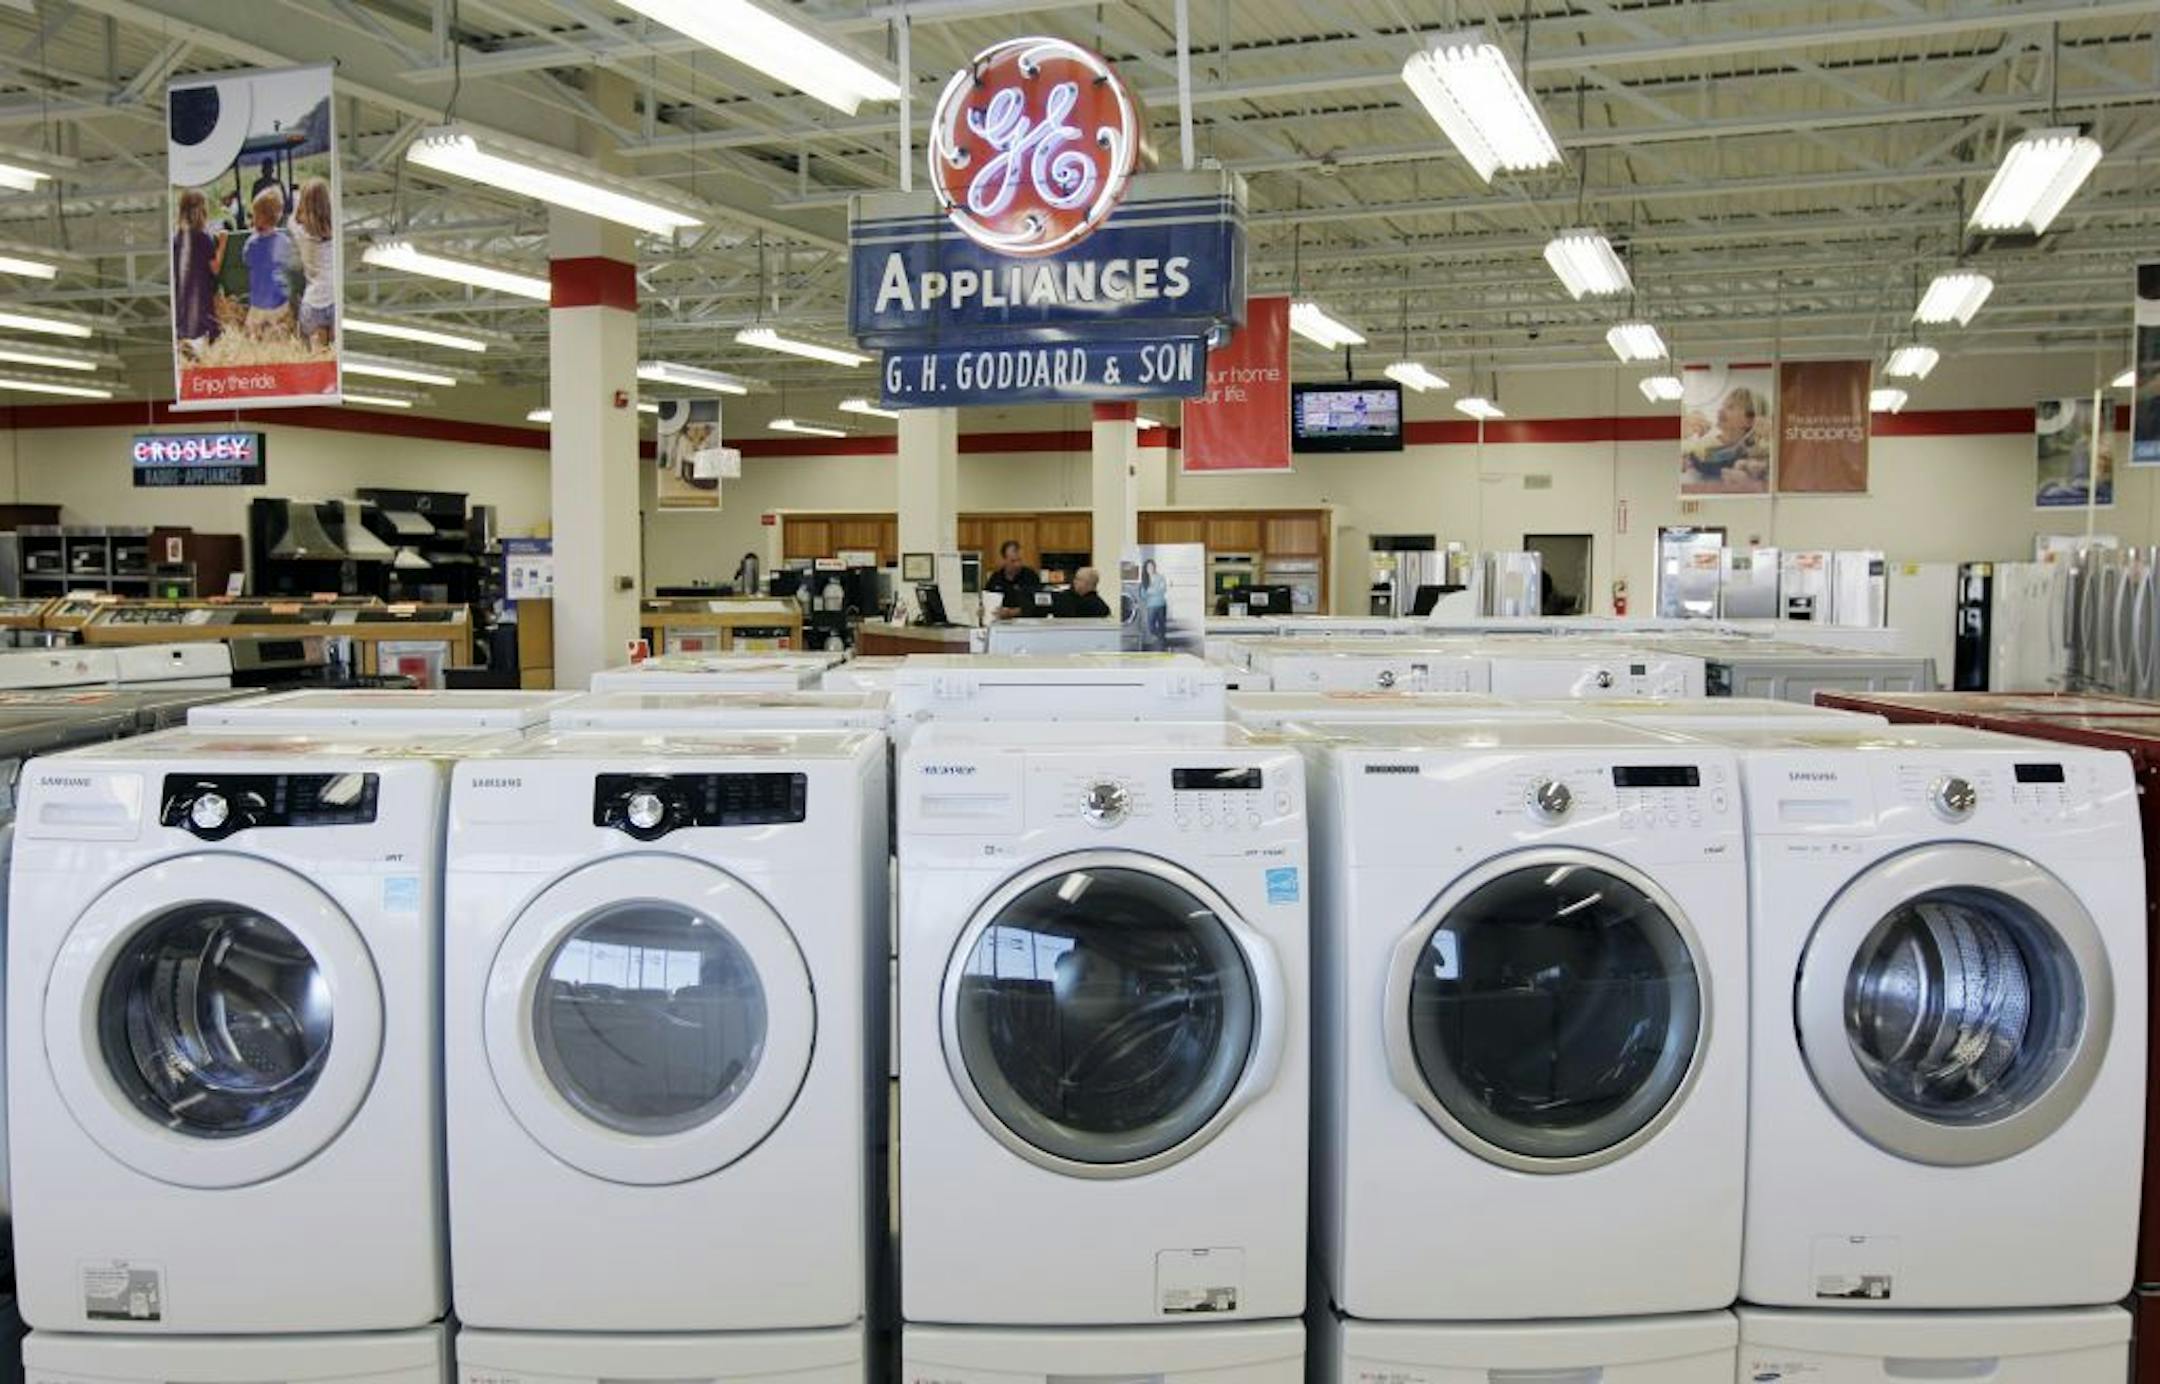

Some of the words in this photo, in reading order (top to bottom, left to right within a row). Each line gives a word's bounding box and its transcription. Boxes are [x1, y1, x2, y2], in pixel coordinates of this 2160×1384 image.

[967, 82, 1098, 217] GE
[874, 252, 1191, 314] APPLIANCES
[886, 355, 913, 394] G.
[920, 355, 947, 392] H.
[956, 348, 1087, 391] GODDARD
[1102, 355, 1121, 384] &
[1138, 343, 1193, 384] SON
[1230, 366, 1280, 384] home
[192, 375, 226, 394] Enjoy
[227, 374, 250, 391] the
[134, 436, 247, 462] CROSLEY
[40, 777, 92, 787] SAMSUNG
